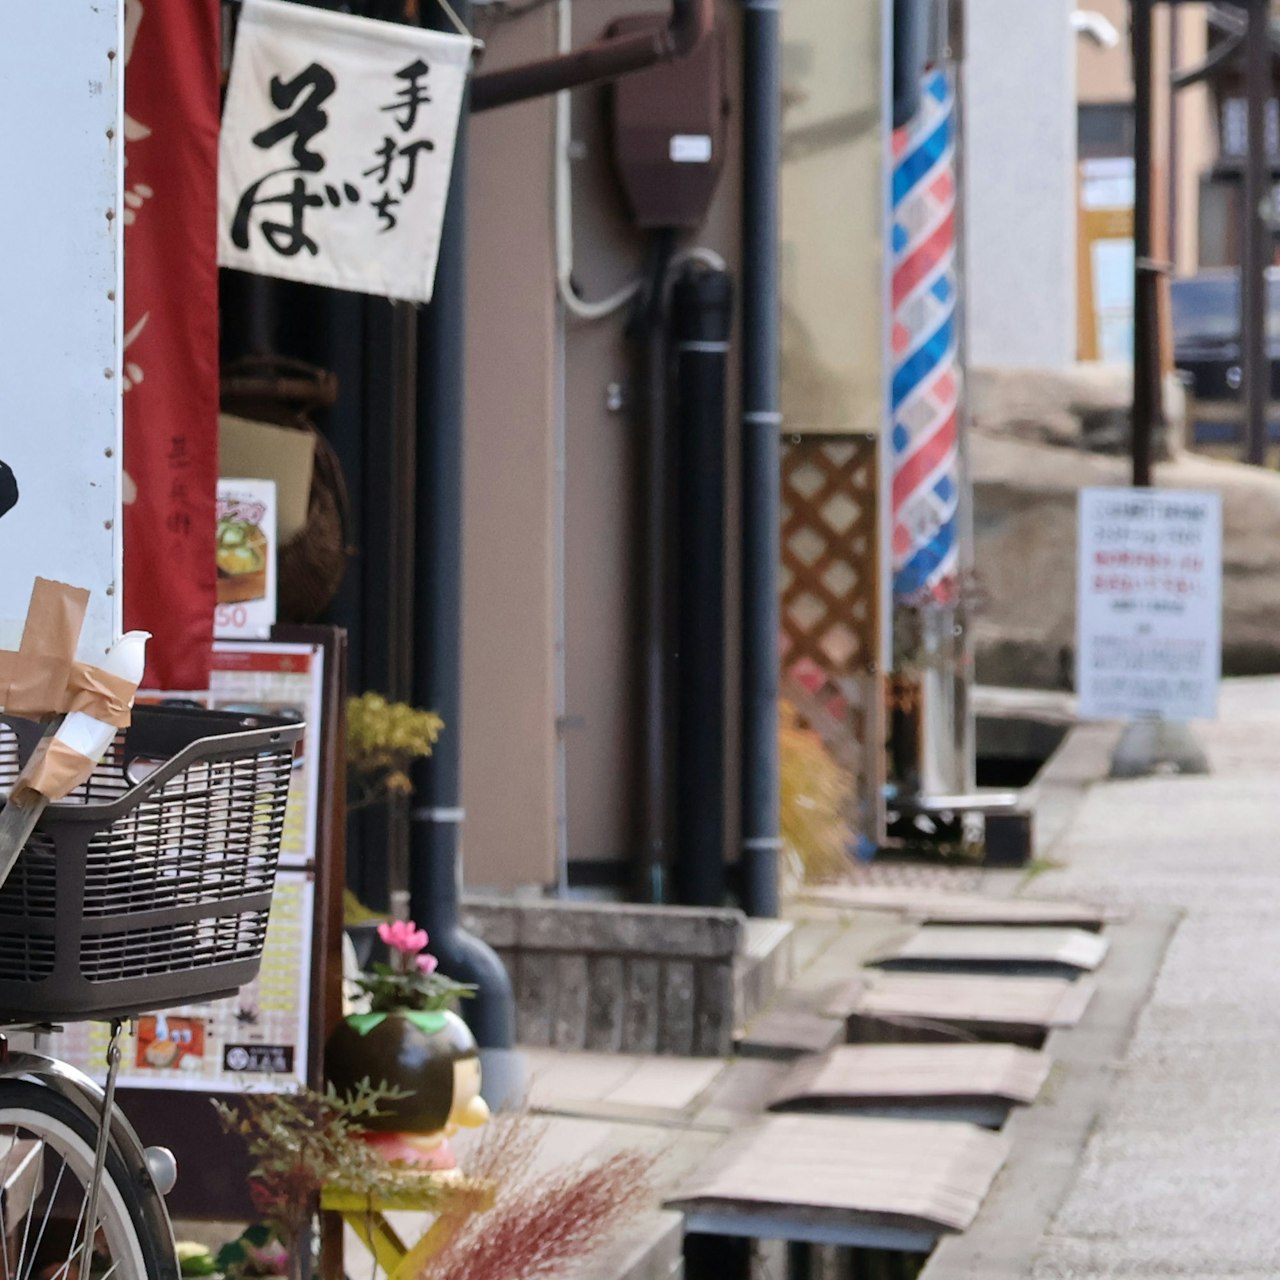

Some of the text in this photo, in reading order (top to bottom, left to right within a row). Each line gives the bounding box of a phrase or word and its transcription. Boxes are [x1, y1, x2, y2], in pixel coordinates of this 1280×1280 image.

[229, 62, 361, 257] そば
[361, 58, 435, 233] 手打ち
